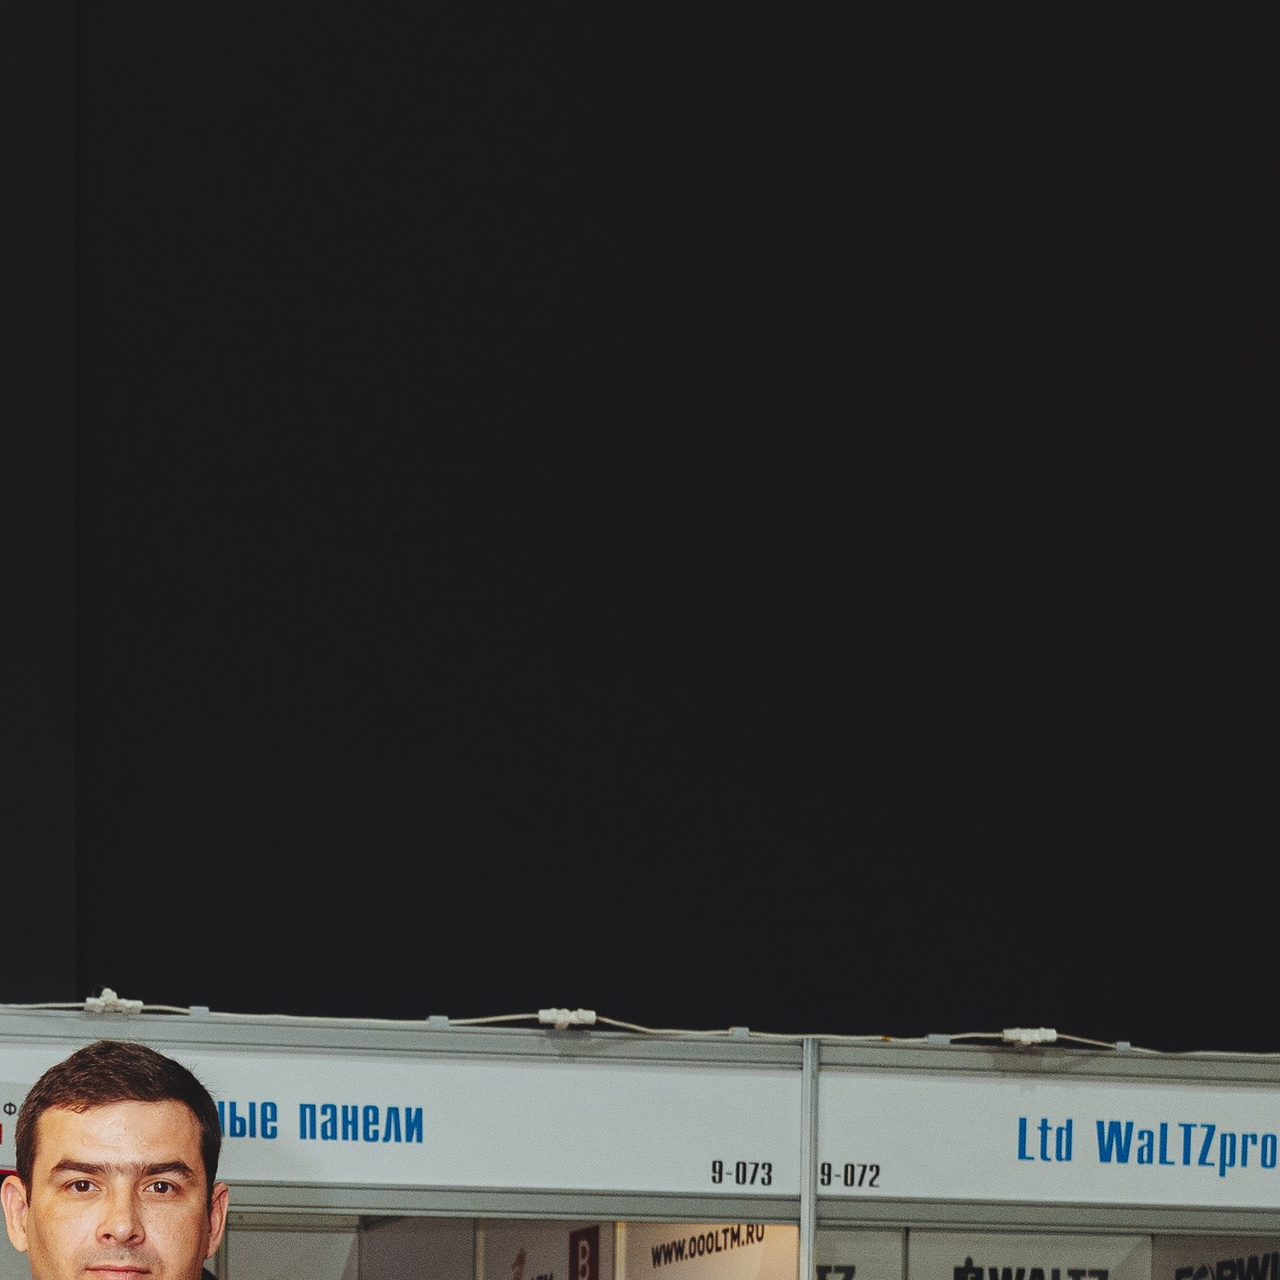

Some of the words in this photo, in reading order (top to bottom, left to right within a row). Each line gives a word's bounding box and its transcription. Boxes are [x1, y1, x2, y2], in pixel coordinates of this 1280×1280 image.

[298, 1102, 424, 1144] панели
[1018, 1117, 1073, 1162] Ltd
[711, 1160, 773, 1187] 9-073
[820, 1163, 880, 1188] 9-072
